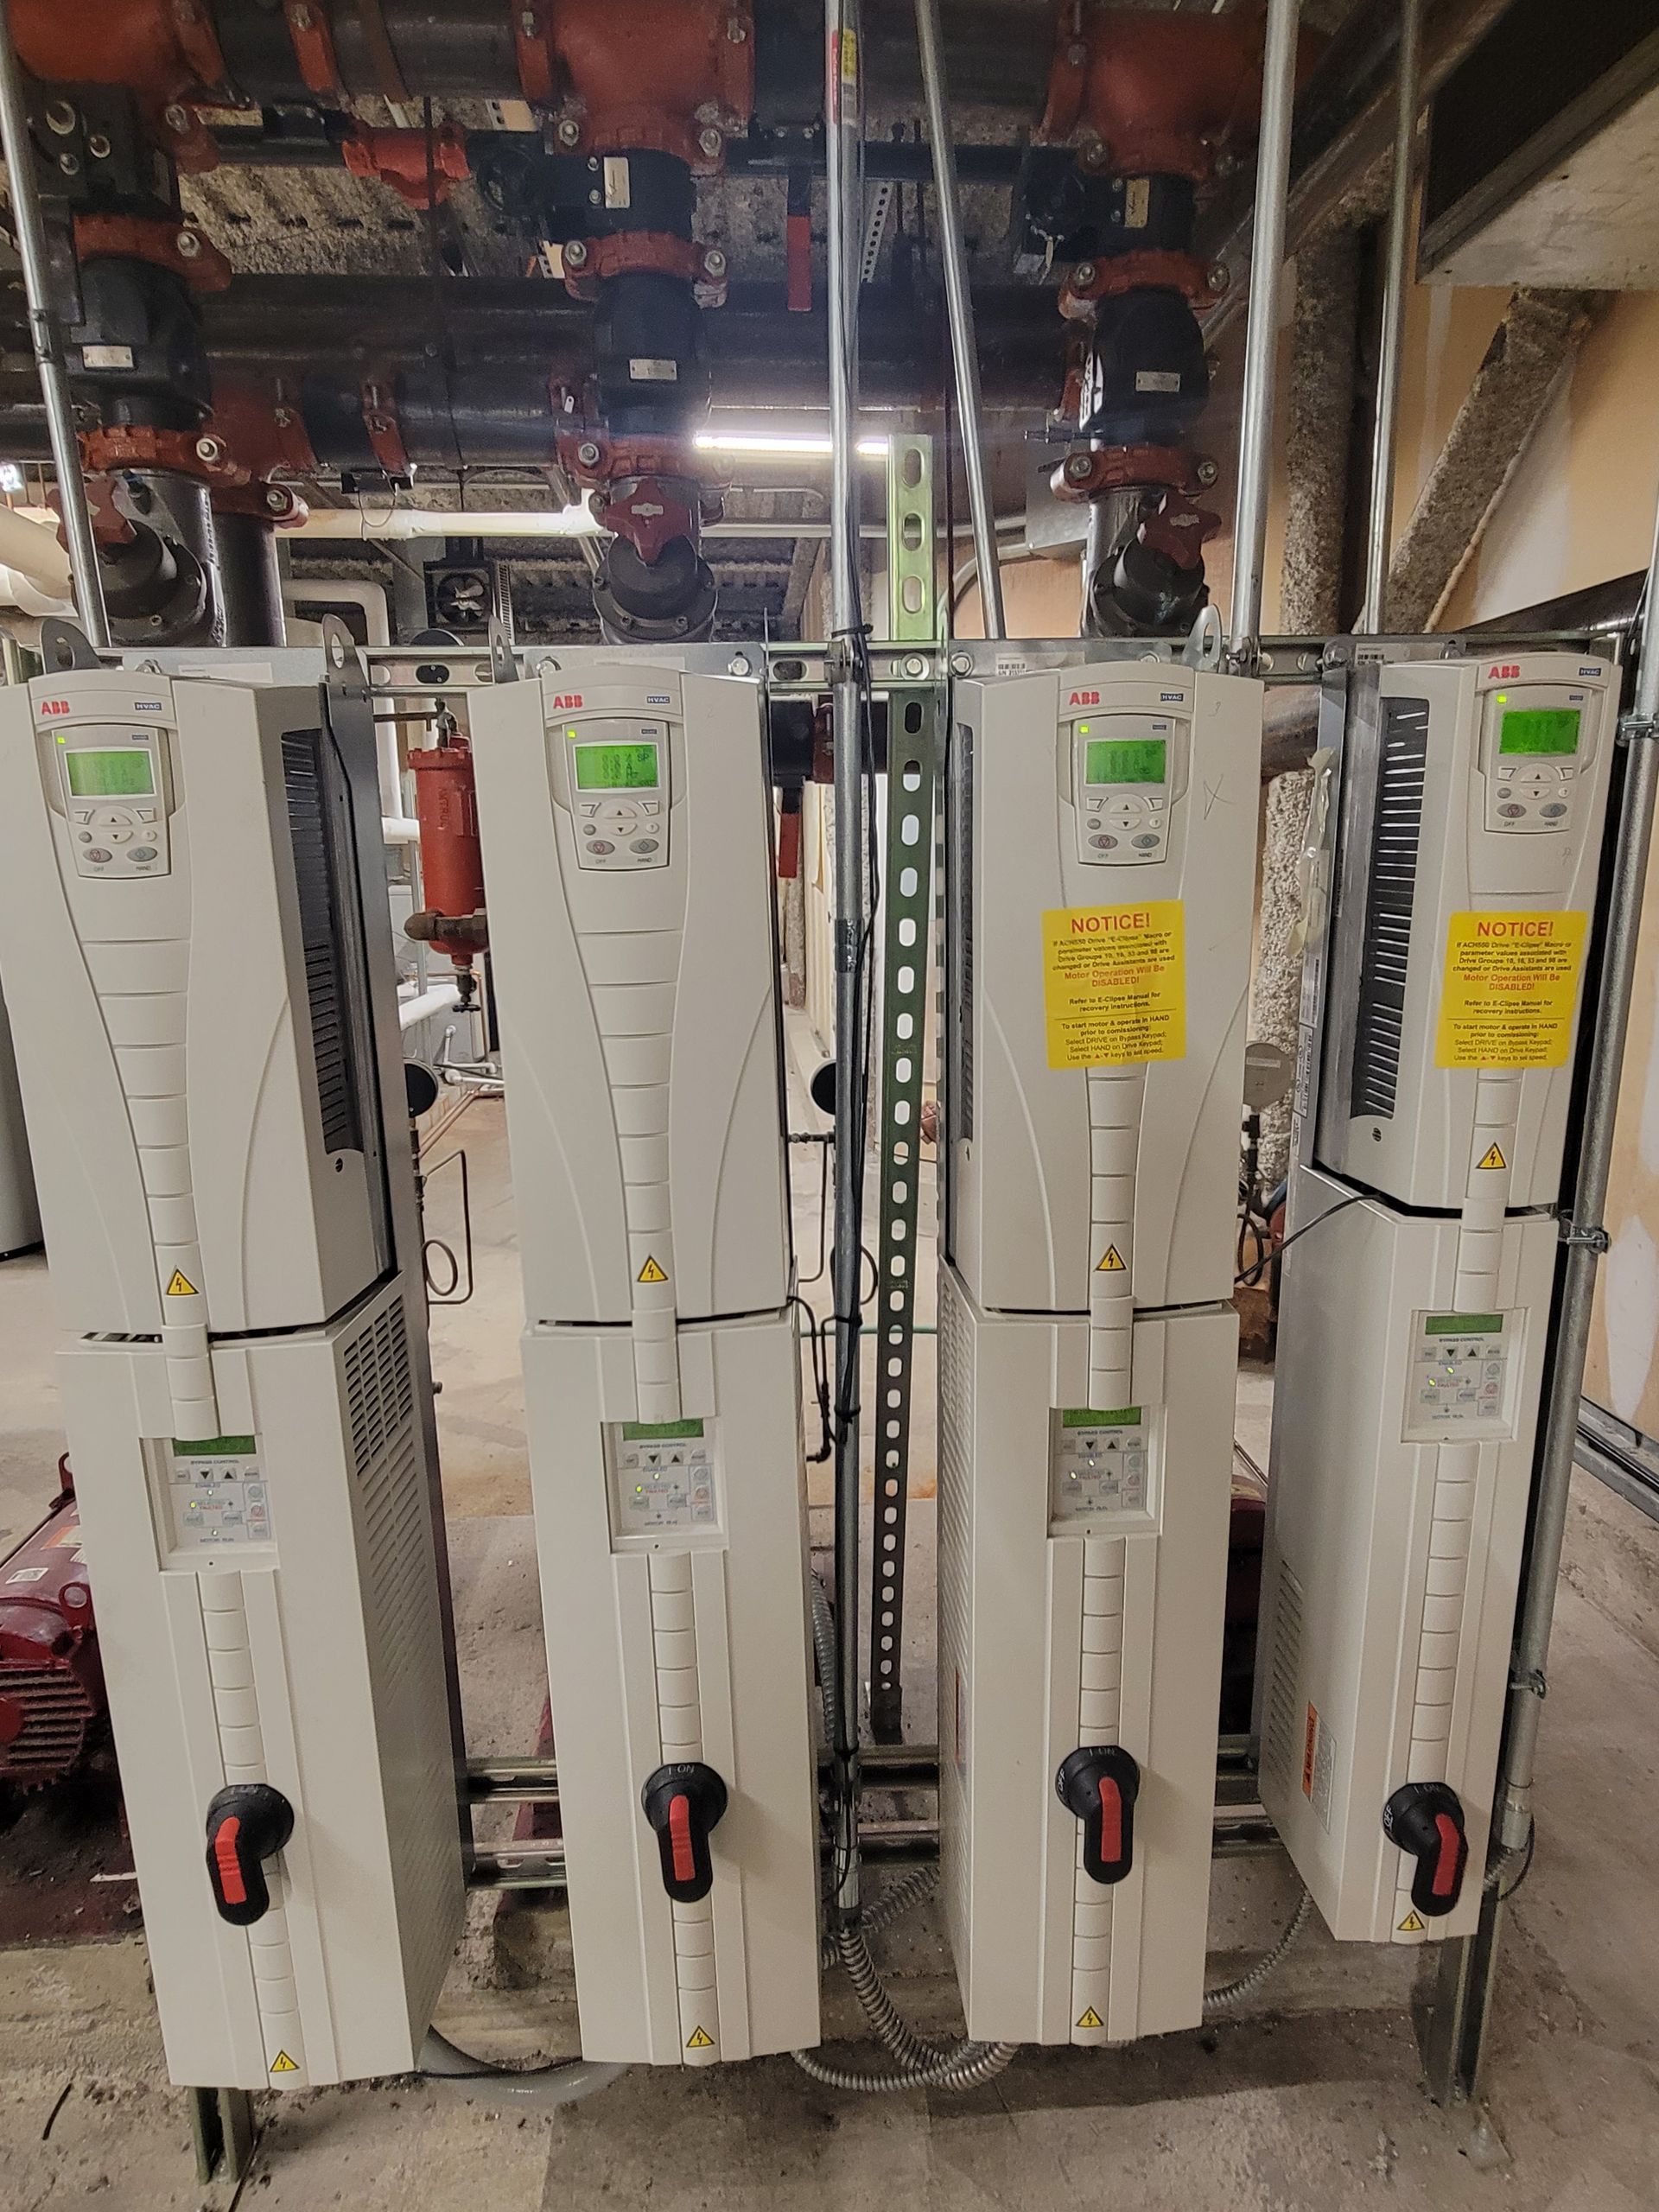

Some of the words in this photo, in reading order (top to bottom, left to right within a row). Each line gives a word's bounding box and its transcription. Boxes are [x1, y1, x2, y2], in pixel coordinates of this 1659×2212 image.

[1488, 665, 1520, 679] ABB
[553, 695, 583, 709] ABB
[1069, 691, 1100, 705] ABB
[1160, 693, 1184, 702] HVAC
[41, 700, 70, 715] ABB
[1071, 912, 1150, 934] NOTICE!
[1478, 921, 1554, 937] NOTICE!
[1065, 970, 1090, 980] Motor
[1091, 968, 1135, 978] Operation
[1491, 974, 1531, 982] Operation
[1091, 976, 1140, 988] DISABLED!
[1489, 982, 1535, 991] DISABLED!
[1127, 992, 1150, 1001] Manual
[1079, 1003, 1109, 1013] recovery
[1110, 1001, 1151, 1010] instructions.
[1116, 1017, 1141, 1027] operate
[1080, 1028, 1096, 1037] prior
[1118, 1033, 1141, 1042] Bypass
[677, 1764, 695, 1774] ON
